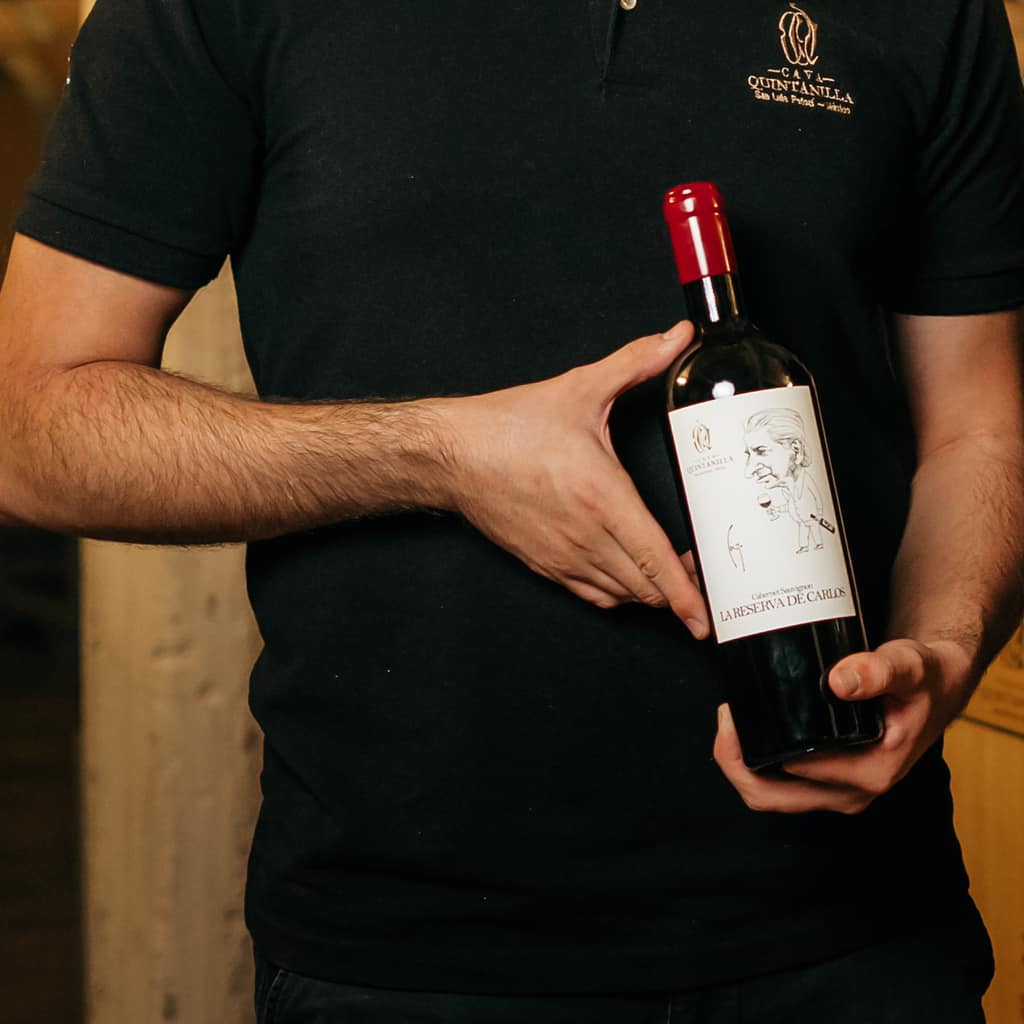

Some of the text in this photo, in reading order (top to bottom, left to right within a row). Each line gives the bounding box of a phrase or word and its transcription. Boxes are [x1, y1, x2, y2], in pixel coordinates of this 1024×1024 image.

[781, 67, 824, 83] CAVA
[747, 74, 855, 104] QUINTANILLA
[754, 89, 770, 101] San
[751, 583, 814, 601] Cabernet Sauvignon
[719, 585, 847, 622] LA RESERVA DE CARLOS
